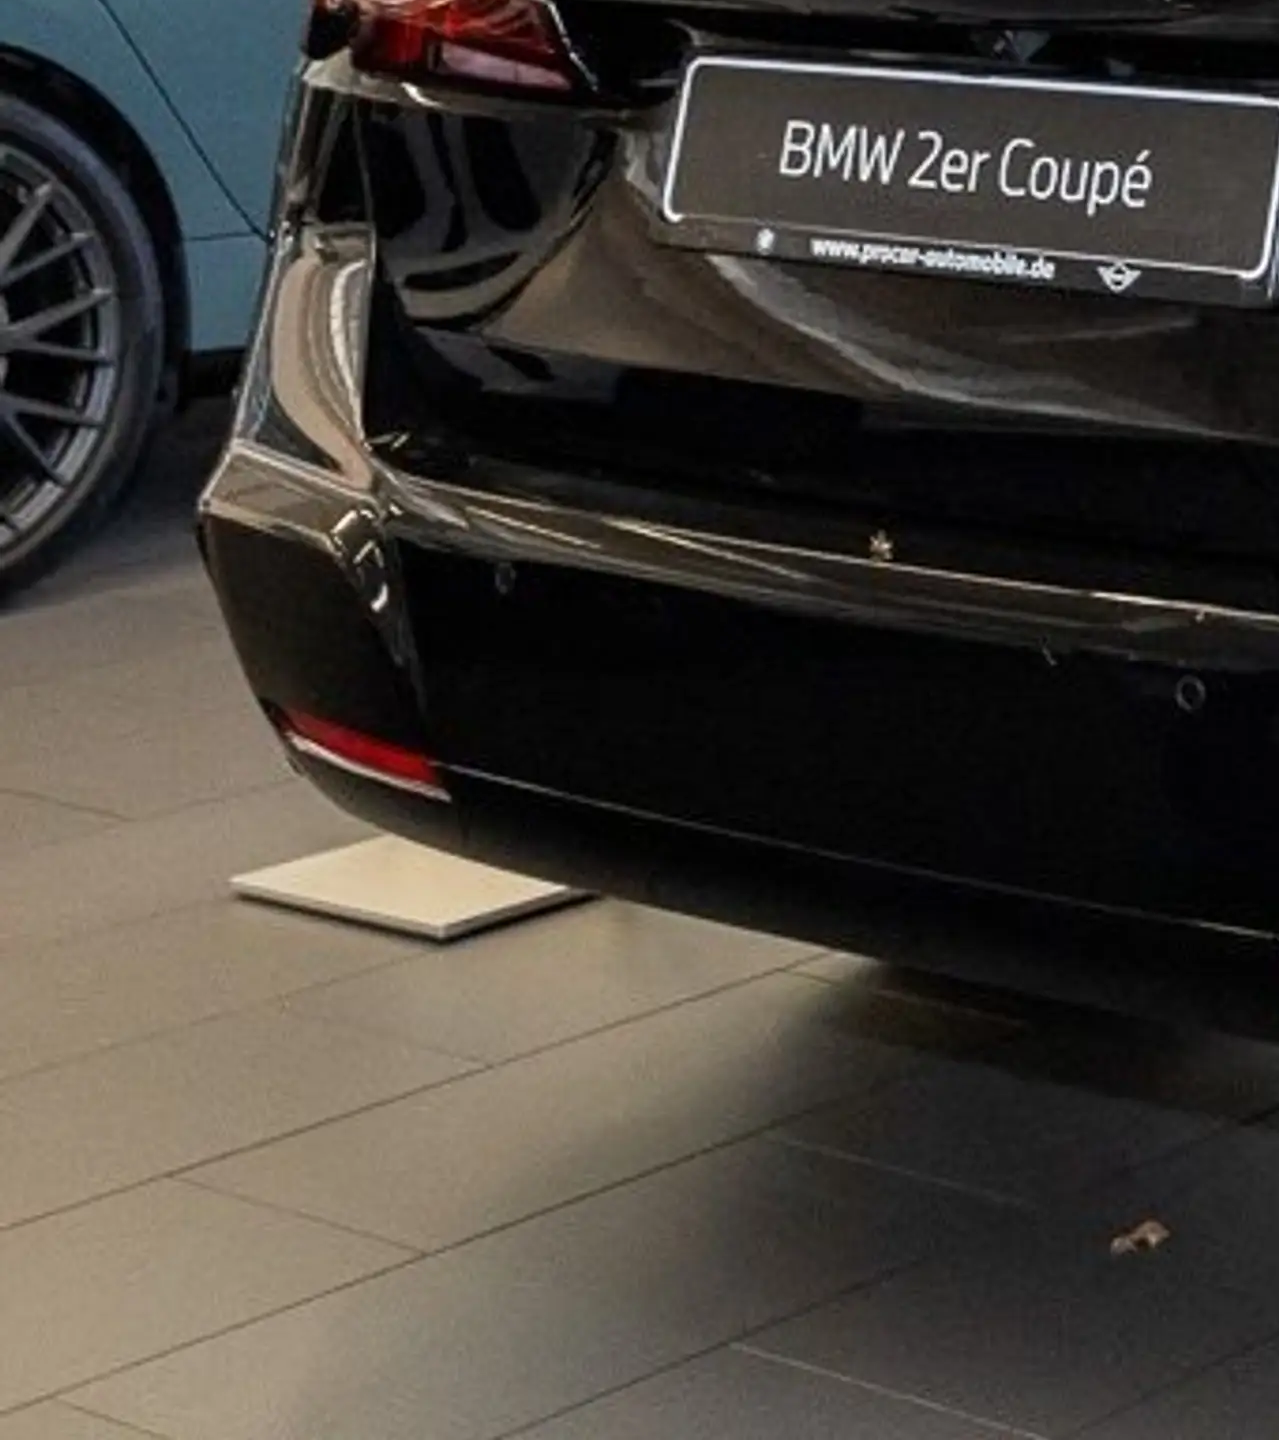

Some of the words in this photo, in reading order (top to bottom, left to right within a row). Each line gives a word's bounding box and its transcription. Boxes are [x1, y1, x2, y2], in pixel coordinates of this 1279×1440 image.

[779, 120, 905, 186] BMW
[907, 130, 991, 193] 2er
[998, 137, 1152, 217] Coupé
